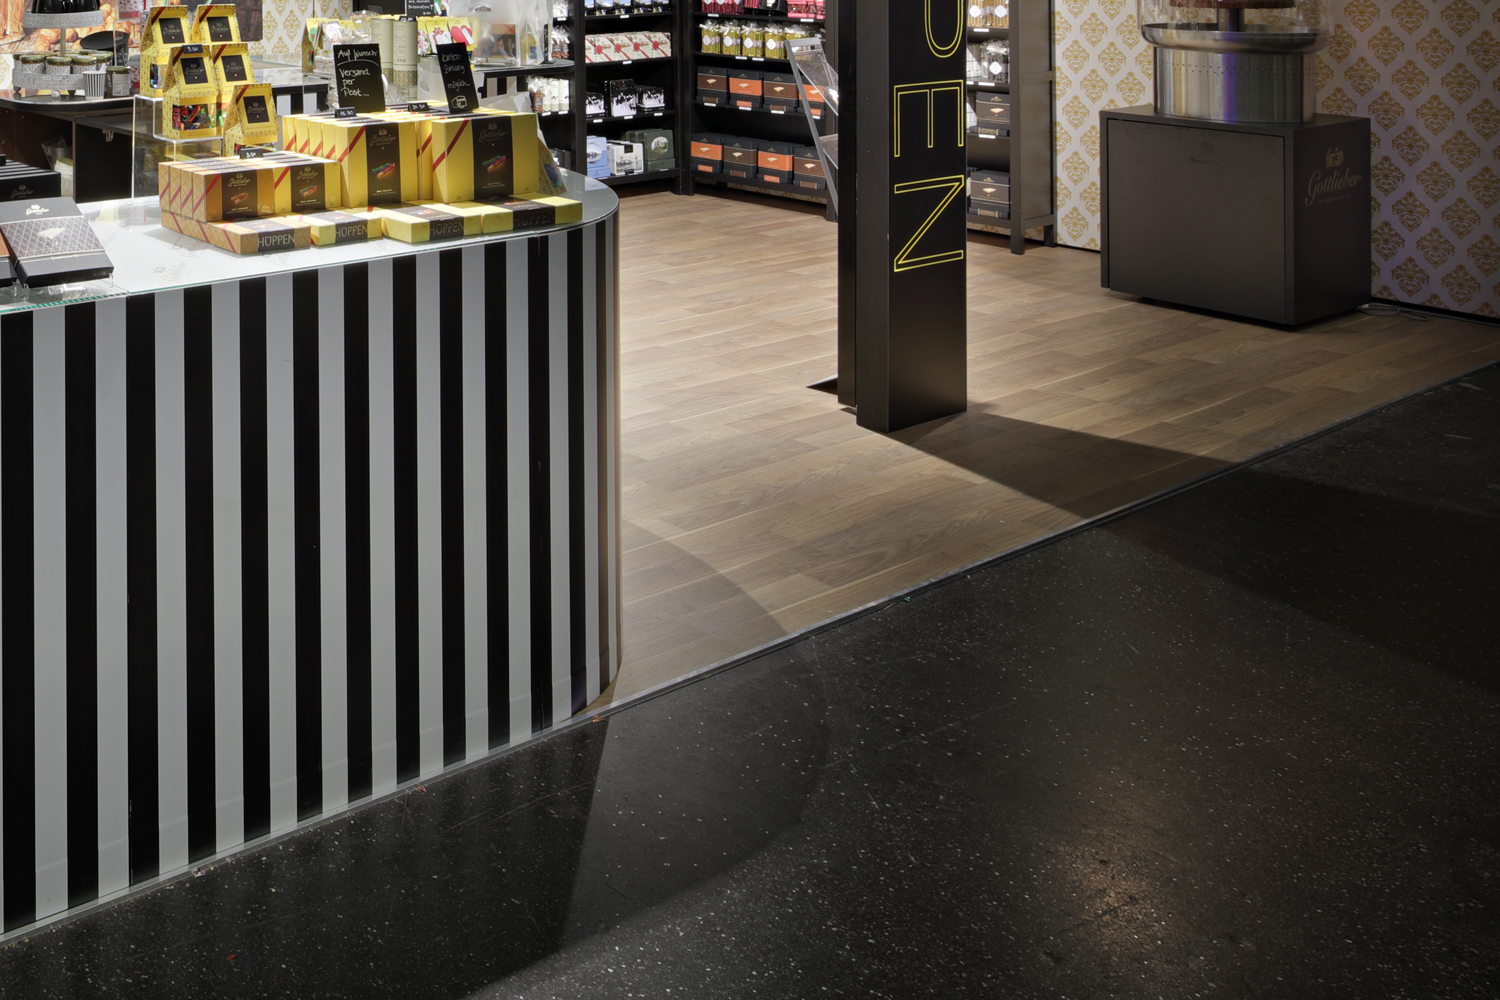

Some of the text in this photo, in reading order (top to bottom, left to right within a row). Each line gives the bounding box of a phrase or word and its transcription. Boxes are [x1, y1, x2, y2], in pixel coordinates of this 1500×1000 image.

[339, 68, 370, 78] Versand
[342, 78, 355, 89] per
[1305, 166, 1362, 207] Gottlieber
[335, 221, 368, 239] HÜPPEN
[430, 219, 464, 235] HÜPPEN
[257, 233, 296, 248] HÜPPEN
